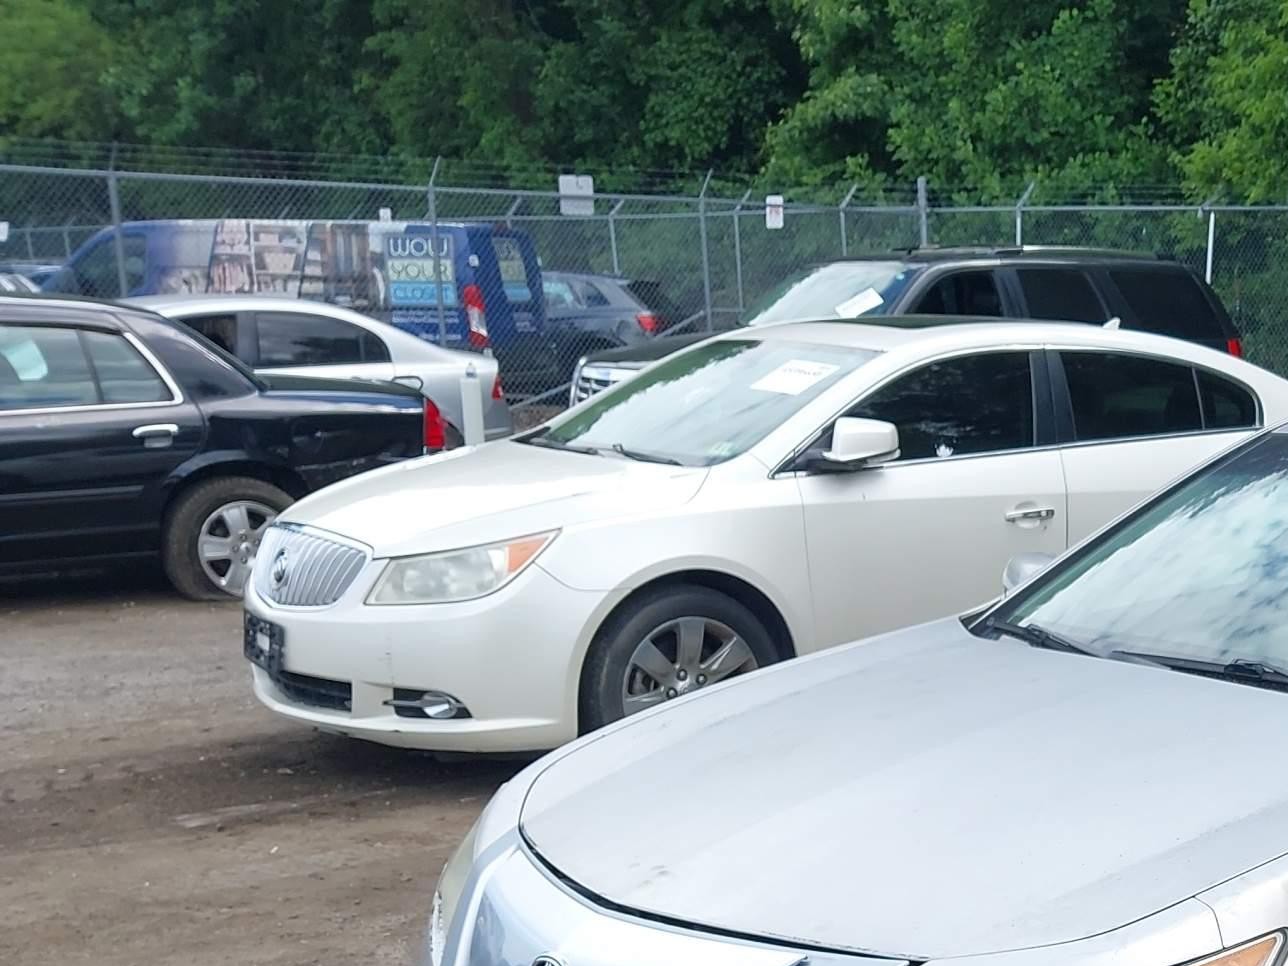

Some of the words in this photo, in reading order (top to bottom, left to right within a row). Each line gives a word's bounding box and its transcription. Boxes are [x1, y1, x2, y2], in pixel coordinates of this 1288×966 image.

[389, 237, 449, 257] WOW
[391, 261, 451, 281] YOUR
[393, 285, 452, 301] CLOST
